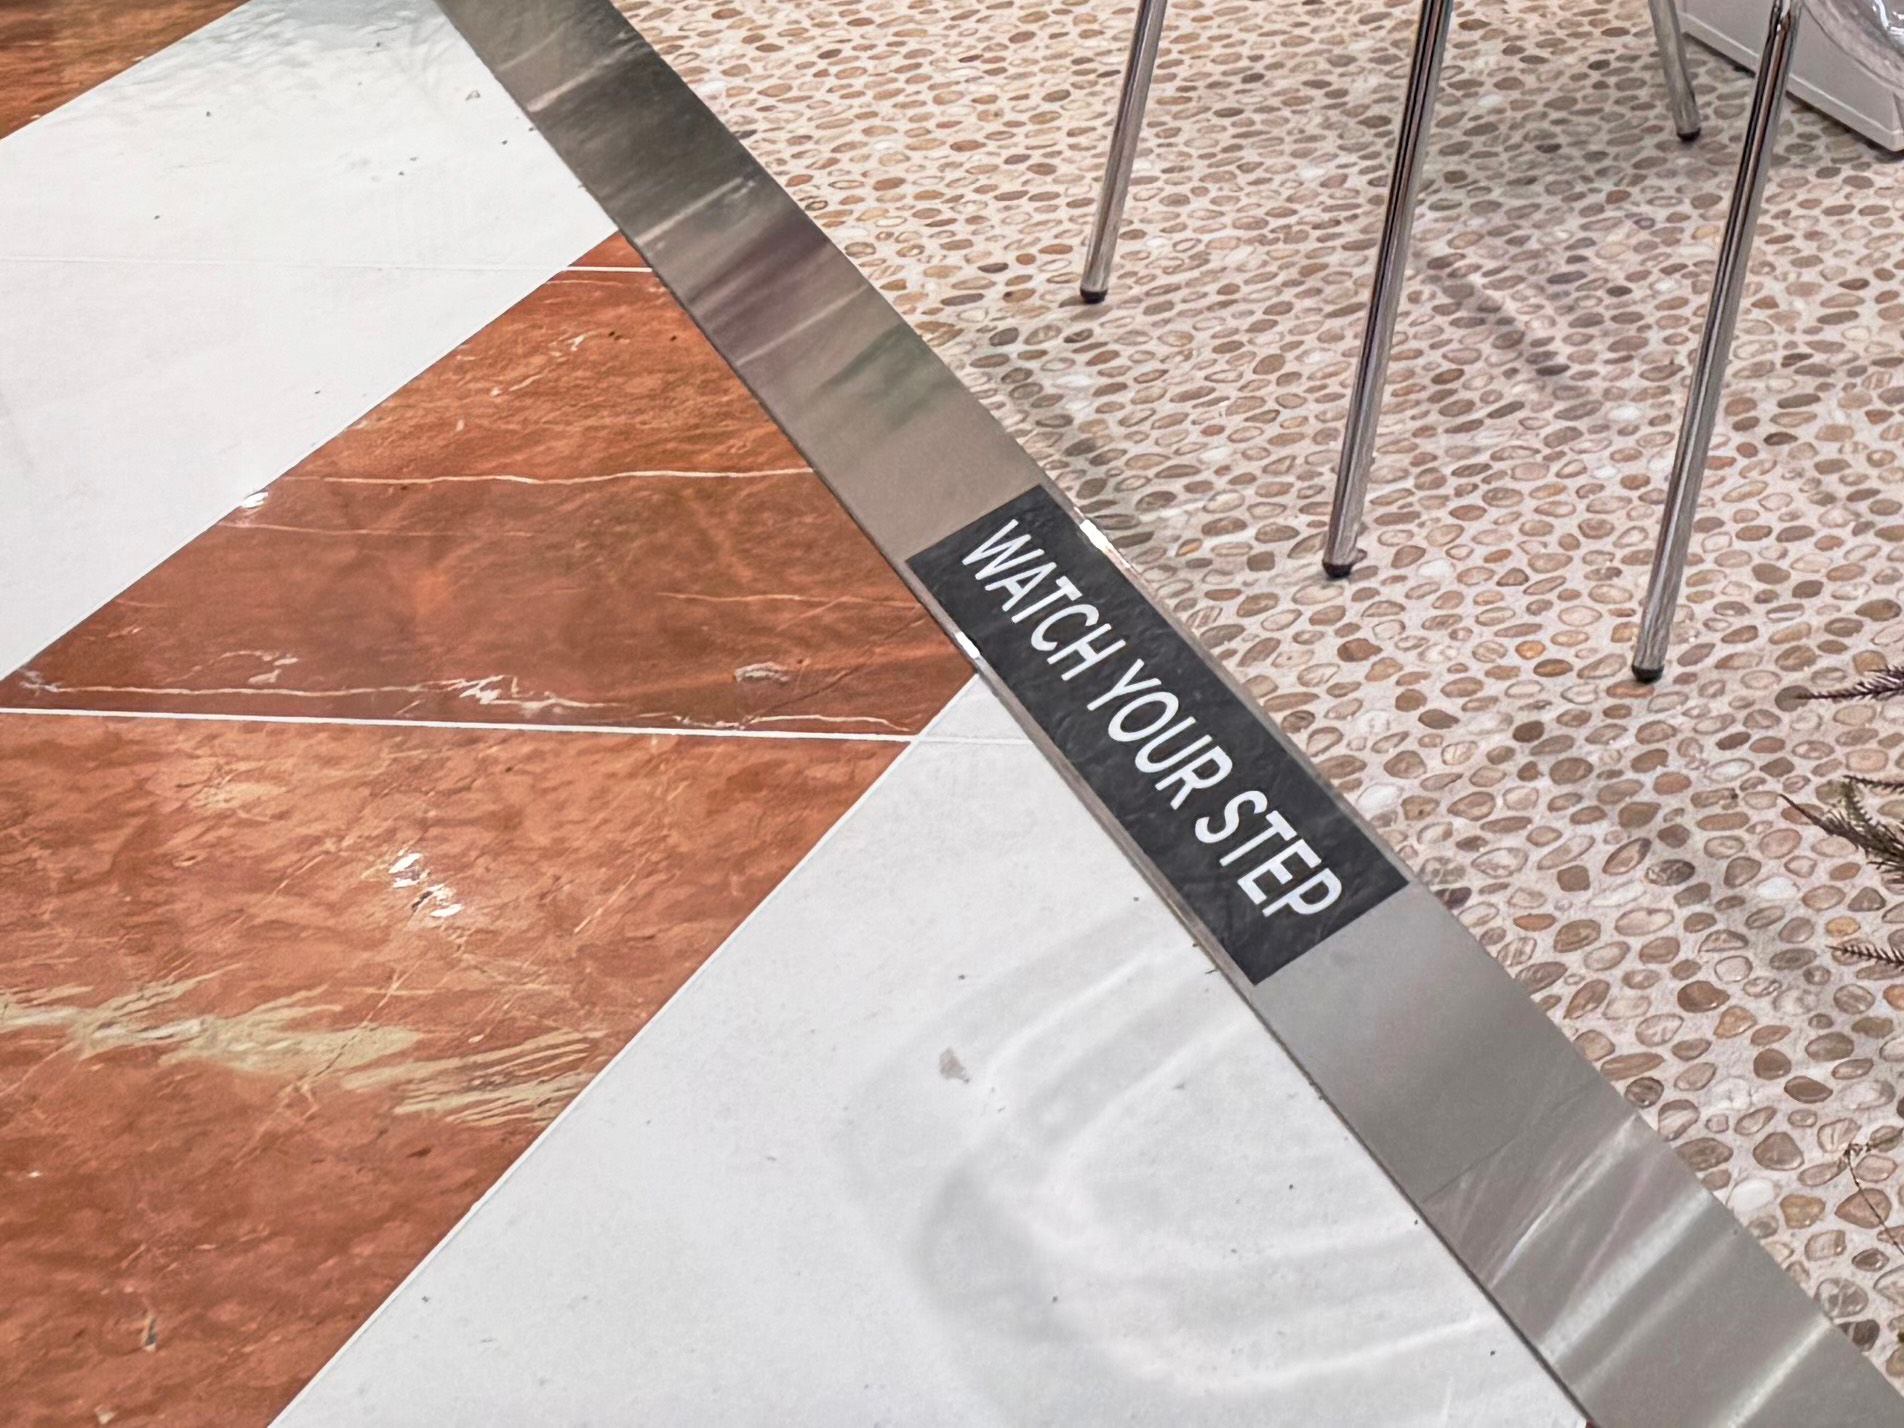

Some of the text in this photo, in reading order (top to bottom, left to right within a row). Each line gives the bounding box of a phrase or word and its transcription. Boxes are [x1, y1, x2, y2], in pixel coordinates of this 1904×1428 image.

[960, 518, 1344, 920] WATCH YOUR STEP
